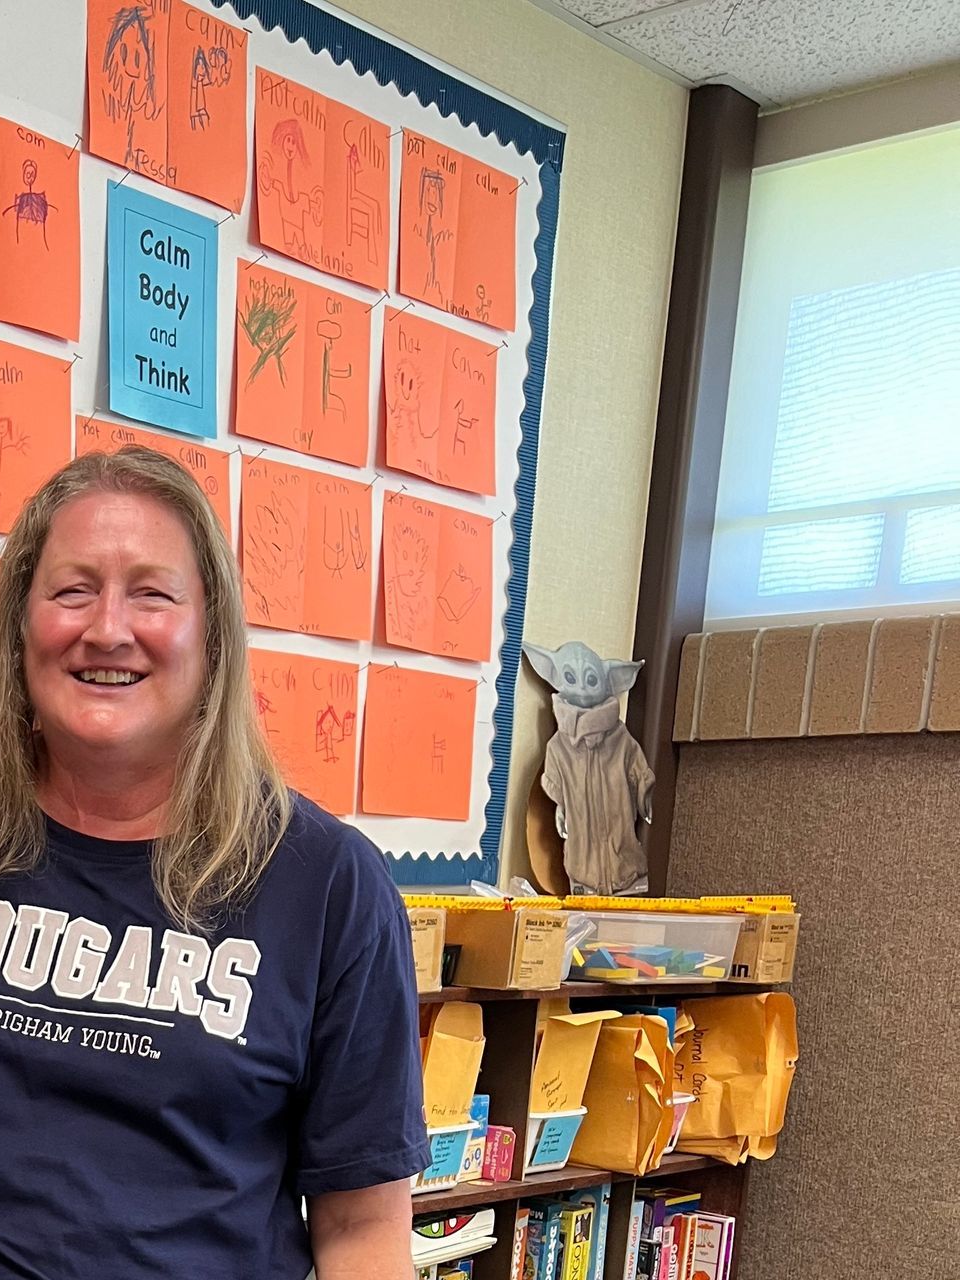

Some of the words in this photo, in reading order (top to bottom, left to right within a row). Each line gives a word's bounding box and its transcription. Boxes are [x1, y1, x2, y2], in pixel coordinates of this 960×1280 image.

[140, 229, 190, 270] Calm
[139, 272, 189, 320] Body
[149, 326, 177, 348] and
[135, 354, 190, 396] Think
[631, 1216, 640, 1248] PUPPY
[628, 1251, 636, 1280] MATH
